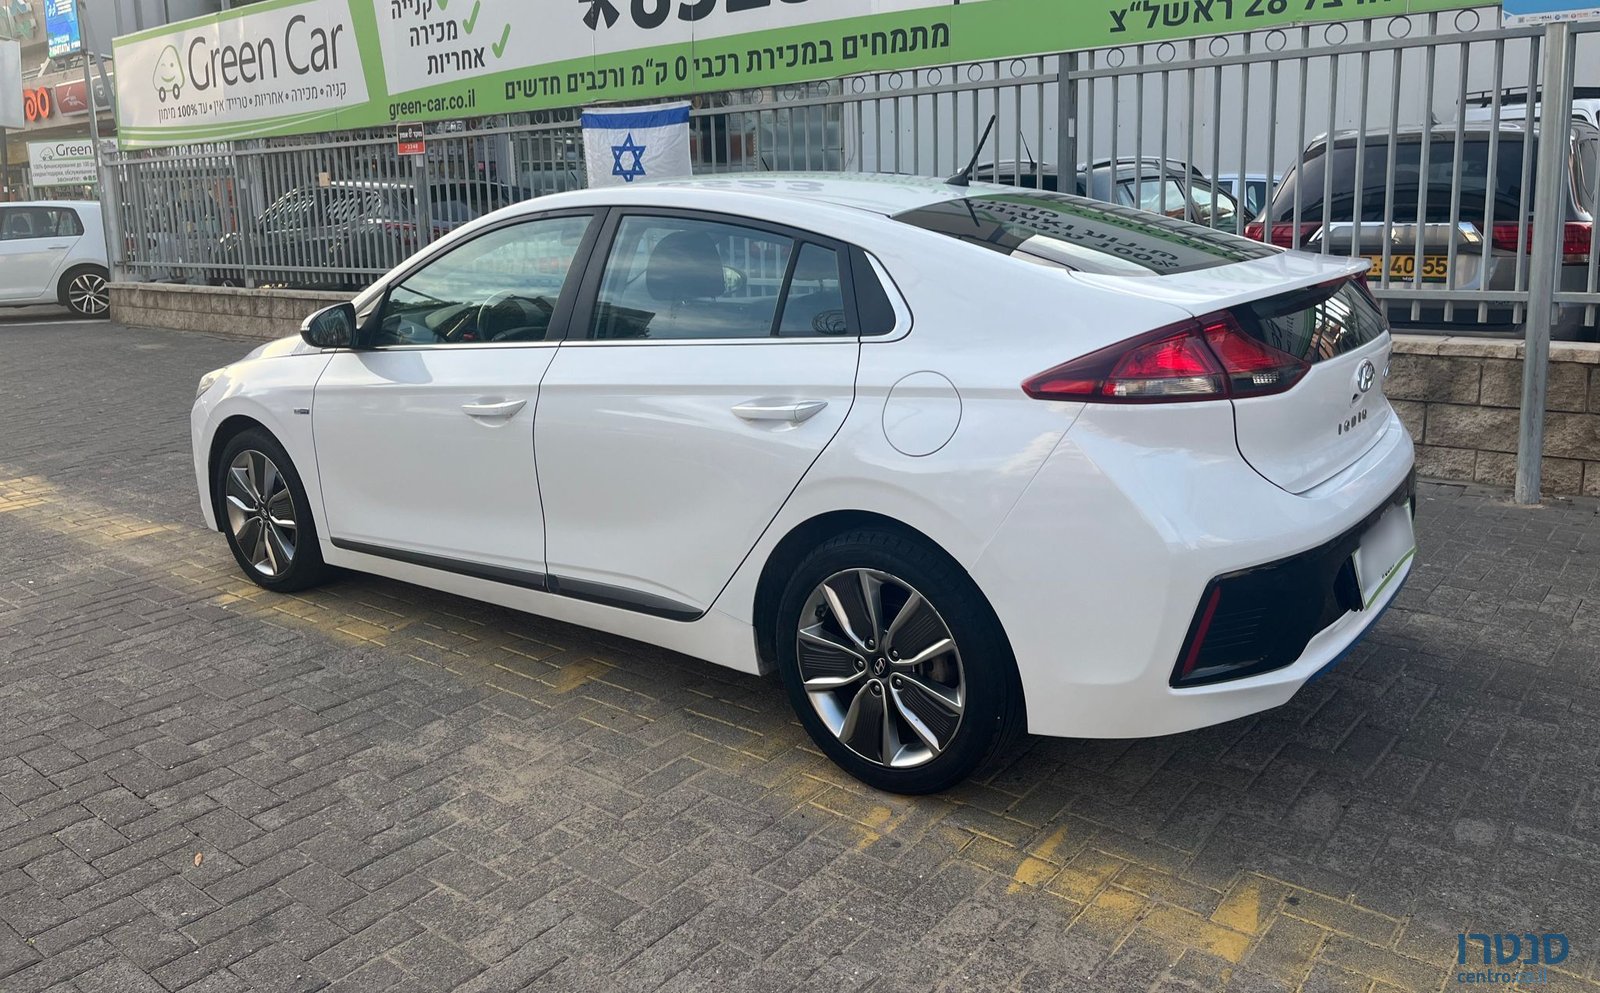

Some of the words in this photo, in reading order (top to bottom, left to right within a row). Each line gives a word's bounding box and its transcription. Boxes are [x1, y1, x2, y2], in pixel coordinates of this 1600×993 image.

[391, 0, 432, 20] קנייה
[409, 19, 458, 47] מכירה
[842, 22, 949, 60] מתמחים
[188, 36, 277, 91] Green
[285, 14, 343, 75] Car
[427, 47, 485, 75] אחריות
[746, 39, 834, 73] במכירת
[675, 55, 687, 81] 0
[693, 53, 739, 79] רכבי
[326, 82, 346, 99] קניה
[505, 75, 561, 100] חדשים
[567, 67, 624, 93] ורכבים
[226, 96, 248, 110] טרייד
[254, 91, 284, 107] אחריות
[291, 87, 318, 102] מכירה
[389, 89, 475, 119] green-car.co.il
[158, 107, 176, 123] מימון
[178, 103, 198, 118] 100%
[198, 103, 208, 114] עד
[213, 99, 225, 115] אין
[56, 144, 92, 156] Green
